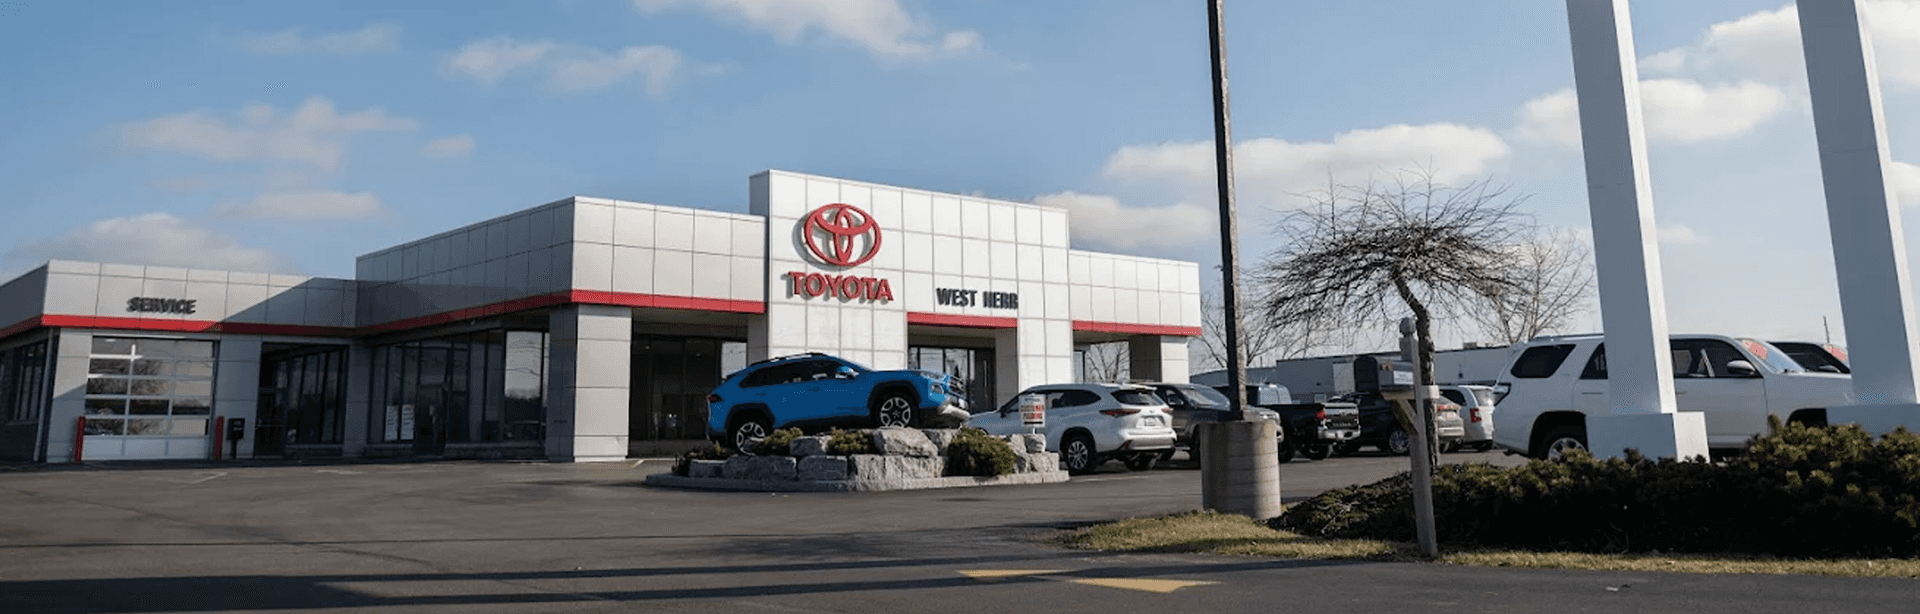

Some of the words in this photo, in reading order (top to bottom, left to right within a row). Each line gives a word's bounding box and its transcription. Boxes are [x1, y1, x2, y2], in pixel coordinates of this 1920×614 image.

[788, 271, 894, 302] TOYOTA
[126, 297, 197, 315] SERVICE
[936, 287, 977, 308] WEST
